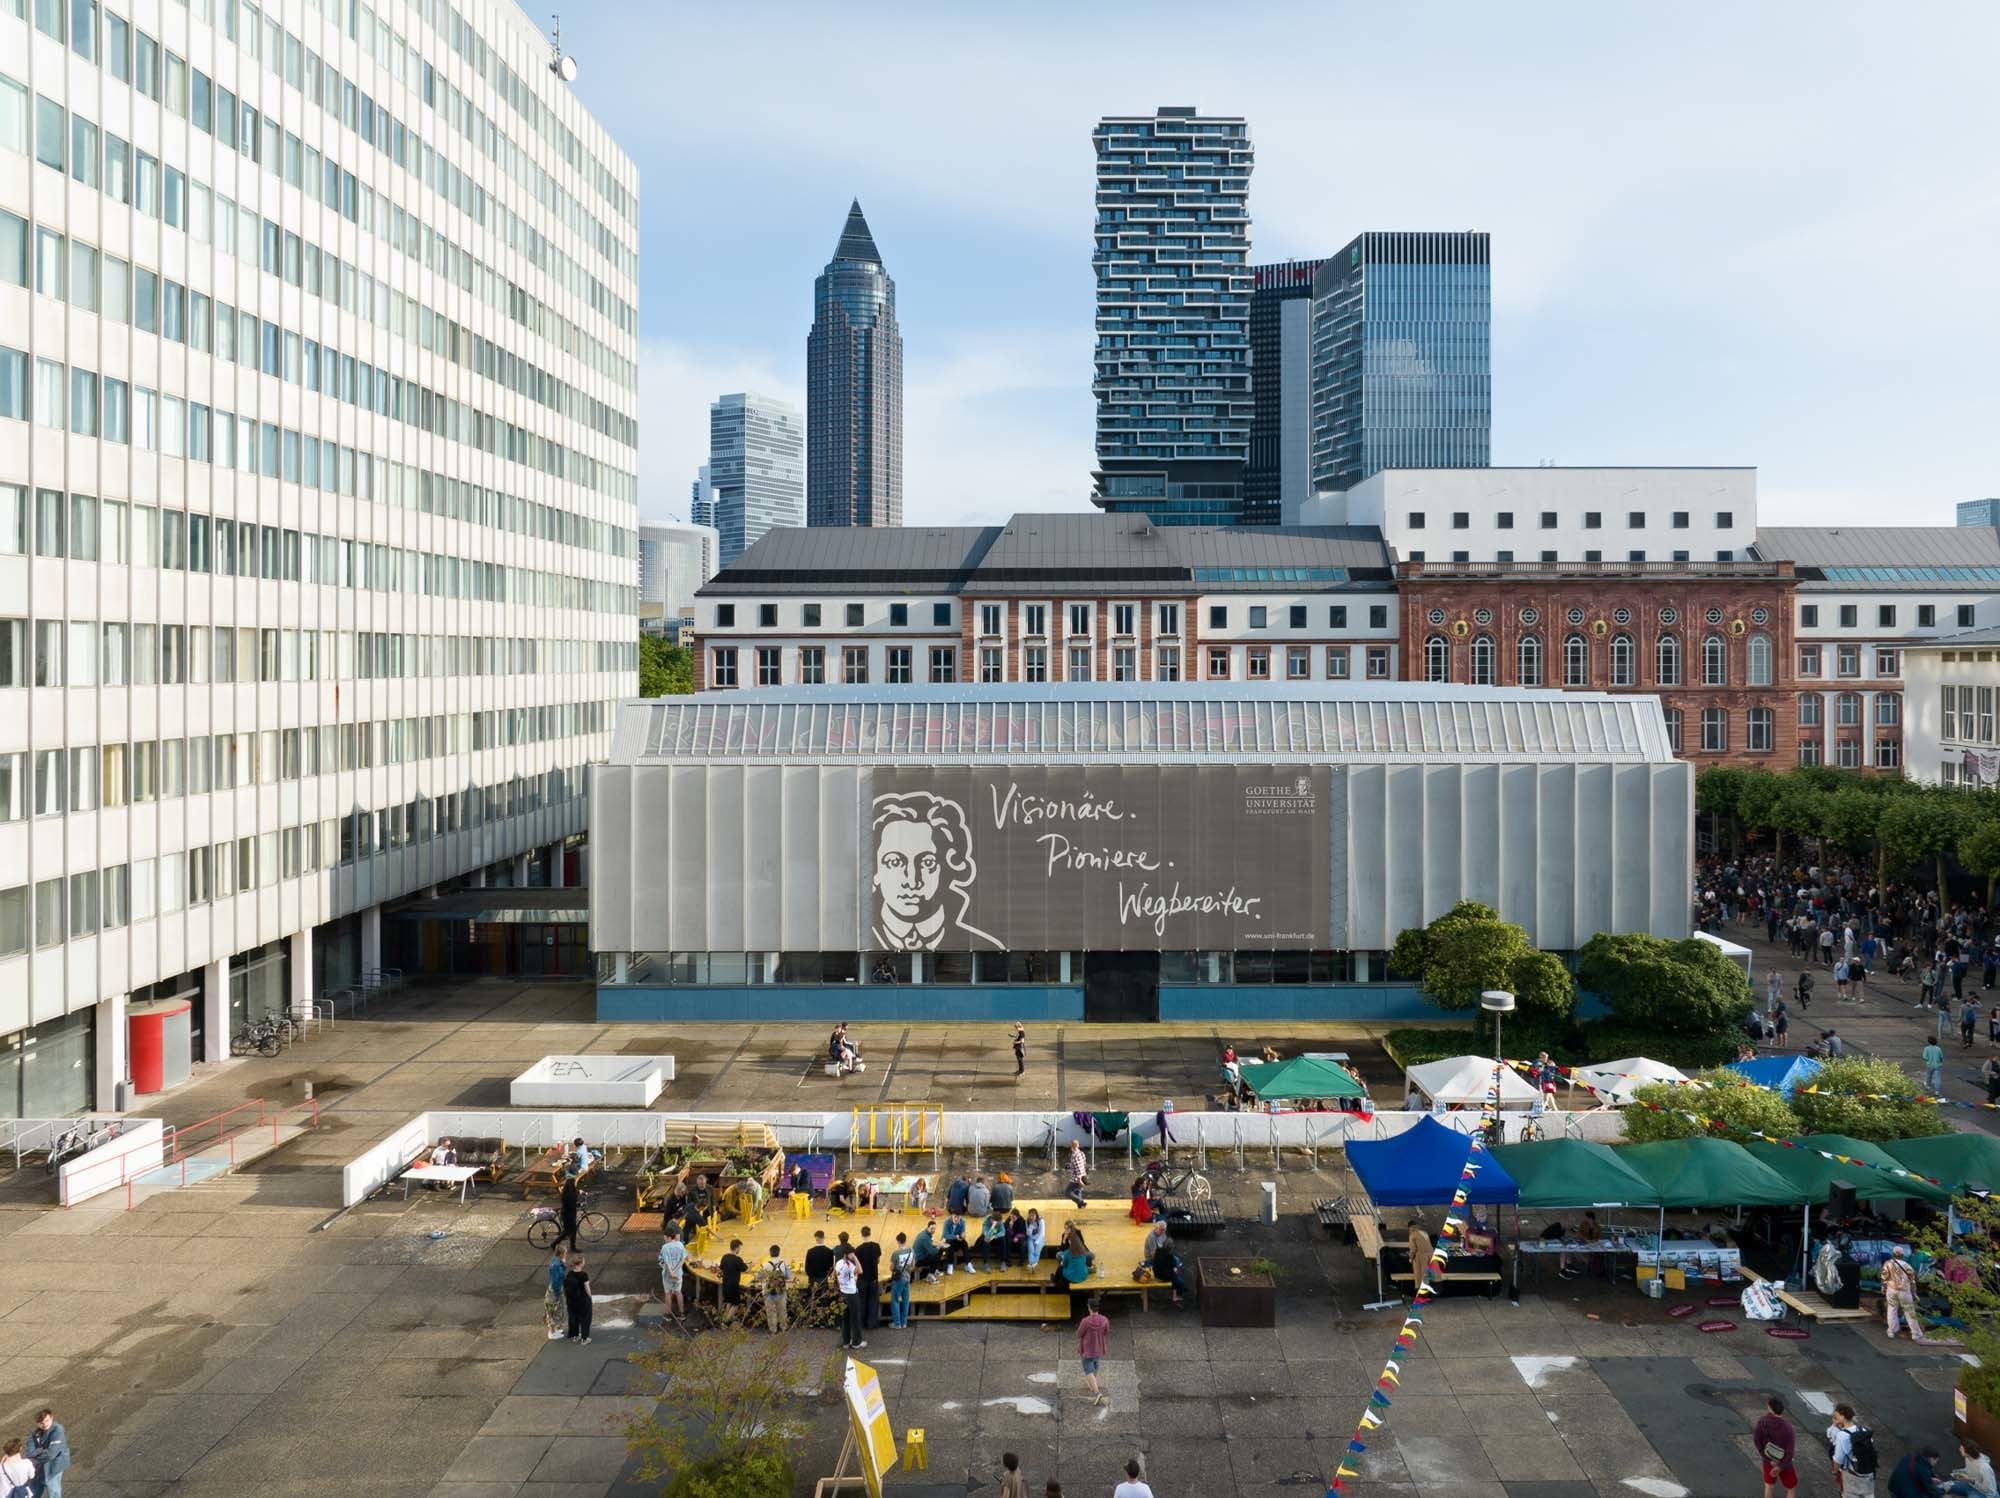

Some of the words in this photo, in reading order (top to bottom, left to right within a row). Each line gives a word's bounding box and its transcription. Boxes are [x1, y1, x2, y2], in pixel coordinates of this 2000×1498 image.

[990, 782, 1137, 830] Visionäre.
[1245, 786, 1292, 796] GOETHE
[1245, 798, 1316, 808] UNIVERSITÄT
[1036, 833, 1175, 879] Pioniere.
[1118, 881, 1261, 937] Wegbereiter.
